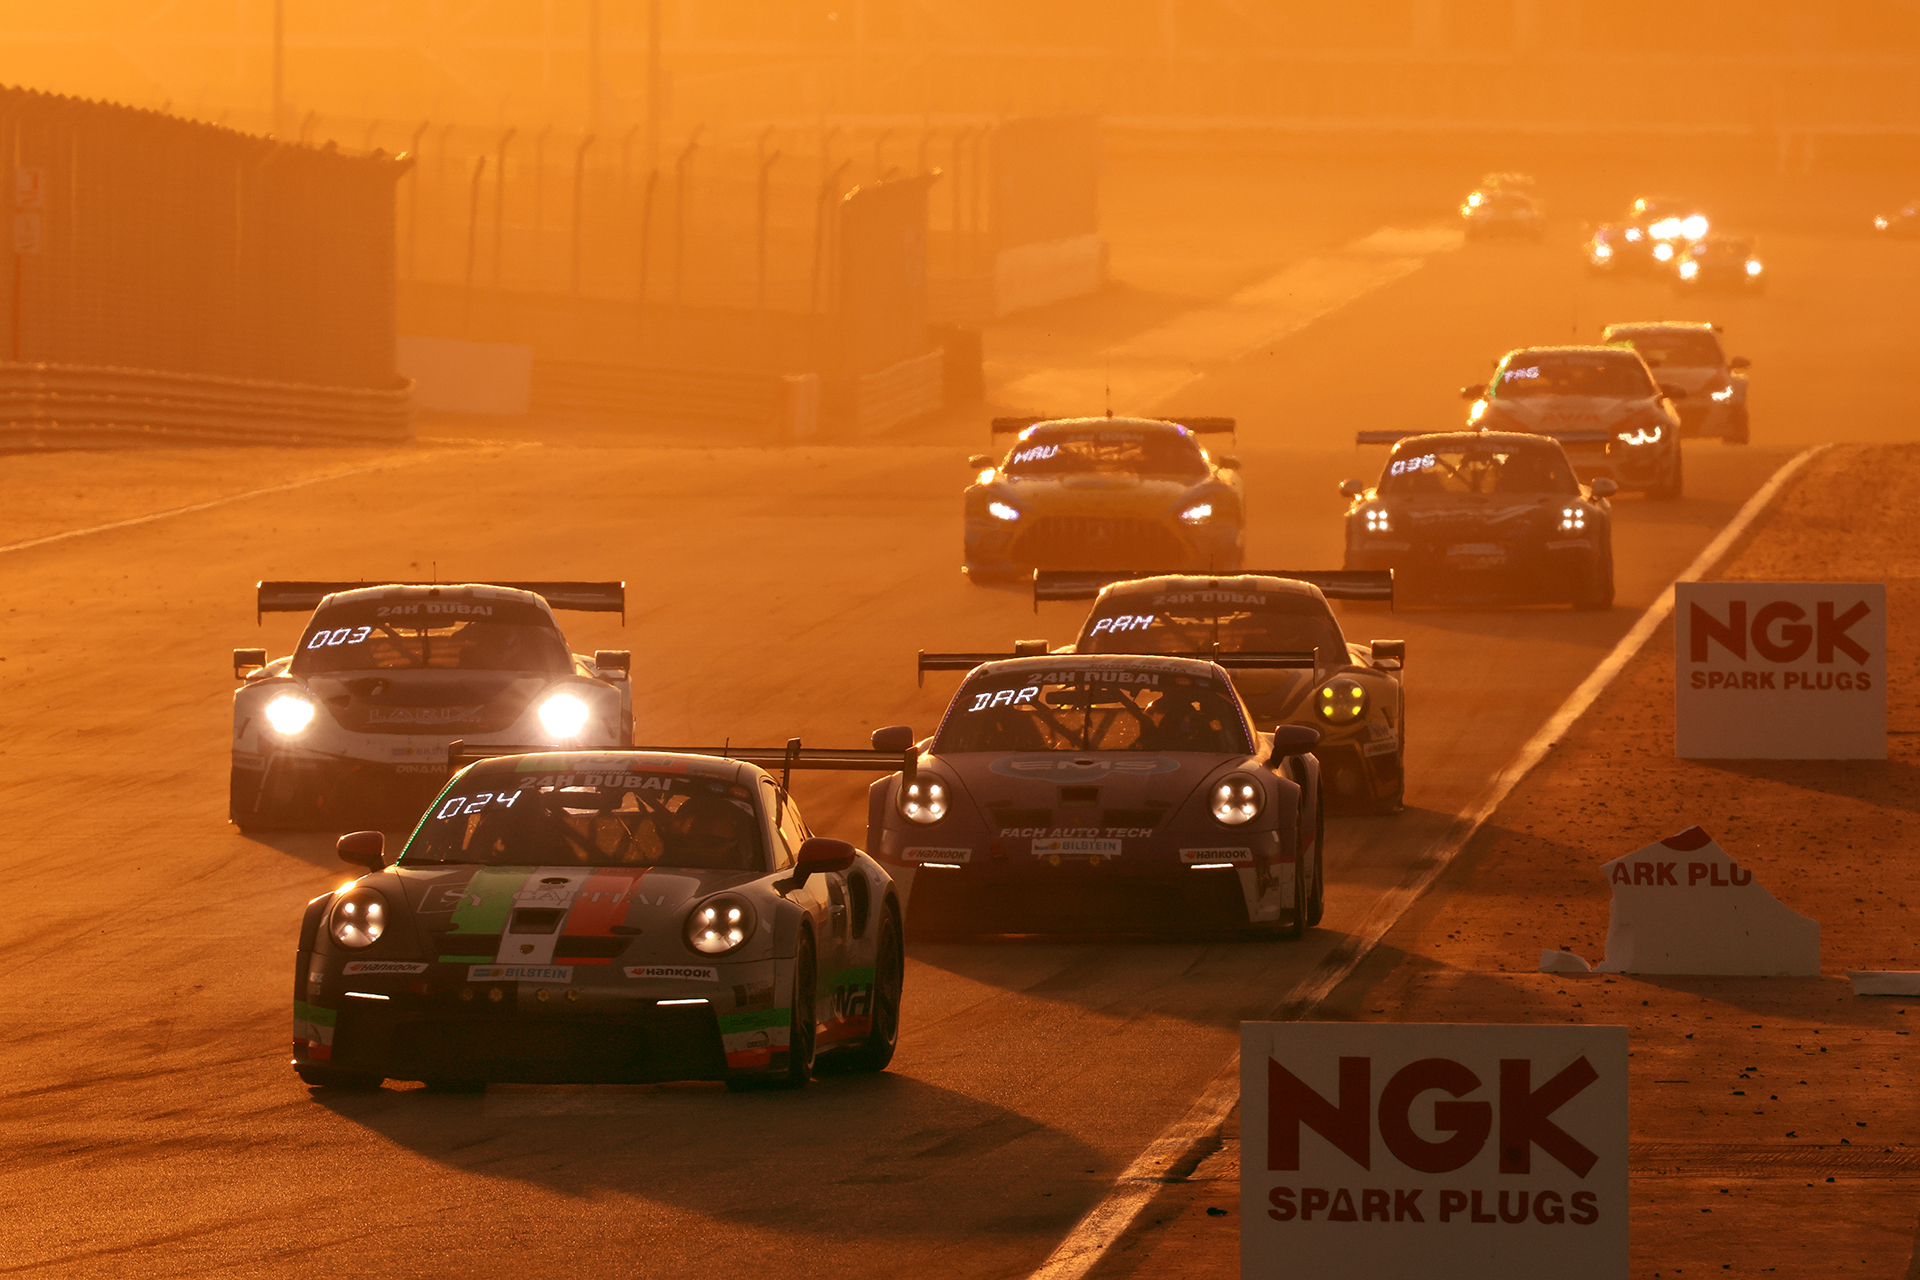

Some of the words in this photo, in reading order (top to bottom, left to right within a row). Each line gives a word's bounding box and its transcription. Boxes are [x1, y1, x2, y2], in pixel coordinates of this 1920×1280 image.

[1151, 594, 1194, 605] 24H
[1202, 593, 1266, 605] DUBAI
[377, 604, 419, 617] 24H
[426, 604, 493, 616] DUBAI
[1089, 614, 1154, 637] PAM
[1690, 600, 1871, 666] NGK
[307, 625, 372, 650] 003
[1027, 672, 1074, 684] 24H
[1083, 672, 1159, 685] DUBAI
[1690, 671, 1776, 690] SPARK
[1783, 671, 1871, 691] PLUGS
[968, 686, 1039, 712] DAR
[1011, 760, 1157, 771] EMS
[518, 775, 575, 789] 24H
[584, 775, 672, 791] DUBAI
[436, 789, 522, 820] 024
[999, 827, 1046, 838] FACH
[1049, 827, 1100, 838] AUTO
[1105, 828, 1153, 838] TECH
[1062, 841, 1116, 851] BILSTEIN
[1611, 862, 1679, 886] ARK
[1688, 862, 1752, 887] PLU
[505, 968, 568, 979] BILSTEIN
[1267, 1055, 1600, 1179] NGK
[1267, 1186, 1426, 1223] SPARK
[1439, 1189, 1600, 1225] PLUGS
